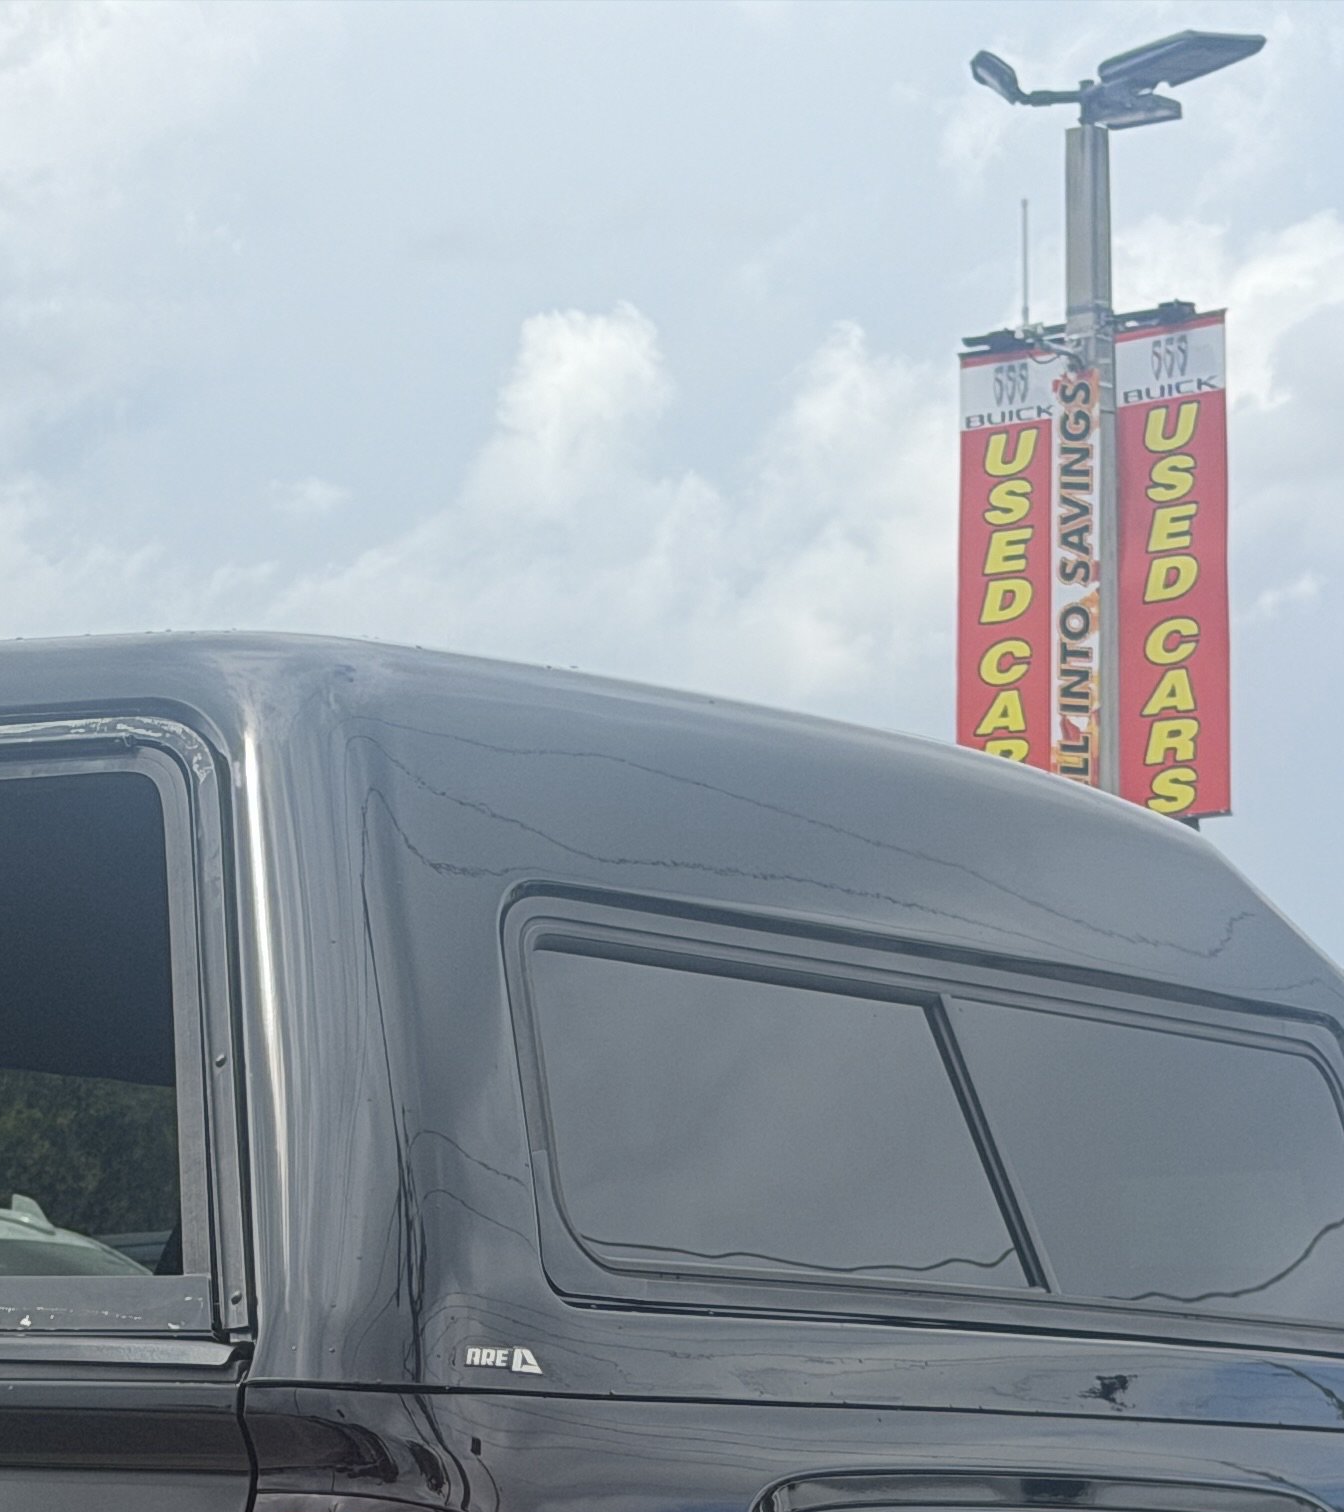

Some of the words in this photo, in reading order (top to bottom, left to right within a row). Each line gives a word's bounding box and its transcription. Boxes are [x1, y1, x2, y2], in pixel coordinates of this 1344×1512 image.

[965, 405, 1053, 429] BUICK
[1123, 375, 1219, 403] BUICK
[979, 427, 1039, 625] USED
[1058, 378, 1093, 586] SAVINGS
[1142, 400, 1201, 604] USED
[1058, 602, 1092, 716] INTO
[1140, 617, 1202, 816] CARS
[1059, 734, 1092, 785] LL
